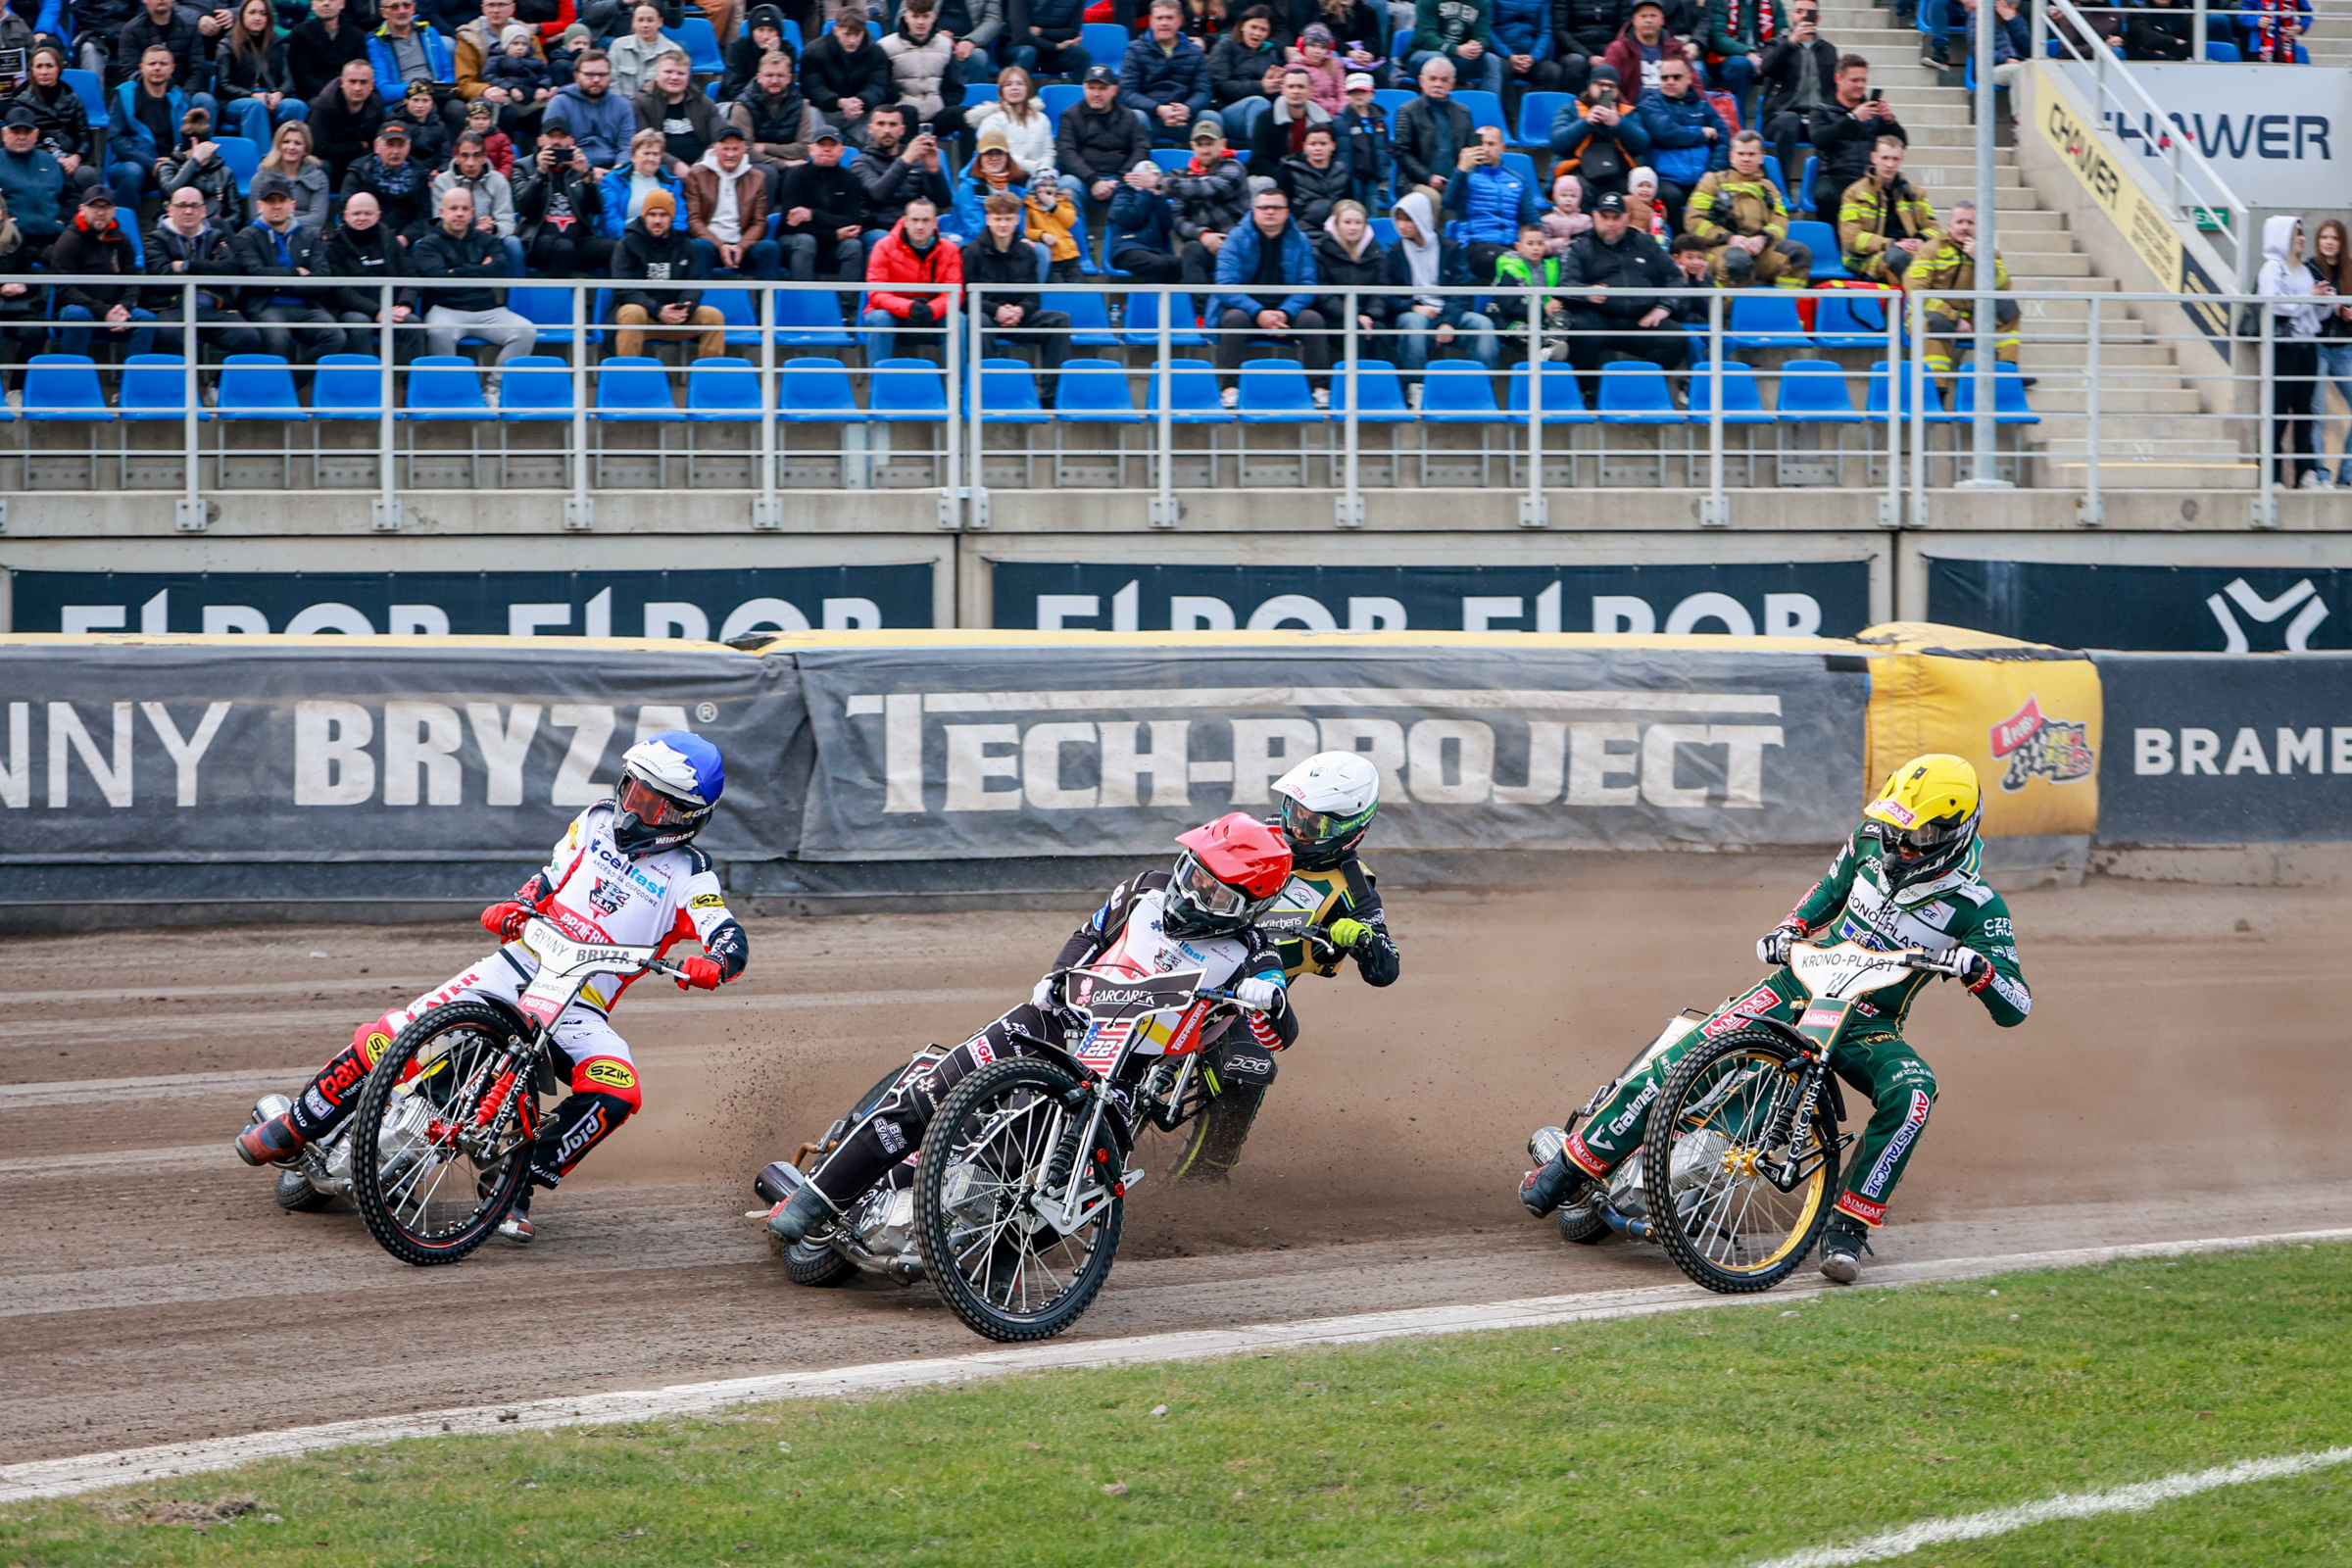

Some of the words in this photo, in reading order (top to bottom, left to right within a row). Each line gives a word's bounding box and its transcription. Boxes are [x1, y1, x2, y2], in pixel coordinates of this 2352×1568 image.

[2103, 112, 2332, 160] HAWER
[2048, 102, 2120, 210] CHAWER
[845, 687, 1785, 814] TECH-PROJECT
[591, 893, 615, 913] WILKI
[1294, 891, 1311, 906] PGE
[1849, 891, 1931, 954] RONO-PLAST
[530, 927, 570, 957] RYNNY
[575, 948, 630, 965] BRYZA
[1801, 953, 1896, 973] KRONO-PLAST
[520, 996, 558, 1014] PROFBUD
[1091, 989, 1155, 1006] GARCAREK
[1170, 1003, 1207, 1052] TECH-PROJECT
[1809, 1012, 1841, 1023] IMPAKT
[975, 1036, 994, 1064] NGK
[1083, 1040, 1118, 1058] 22
[1224, 1054, 1271, 1075] pod
[1608, 1076, 1661, 1137] Galmet
[1788, 1079, 1823, 1159] GARCAREK
[872, 1116, 898, 1153] EVANS
[887, 1122, 907, 1149] BILL
